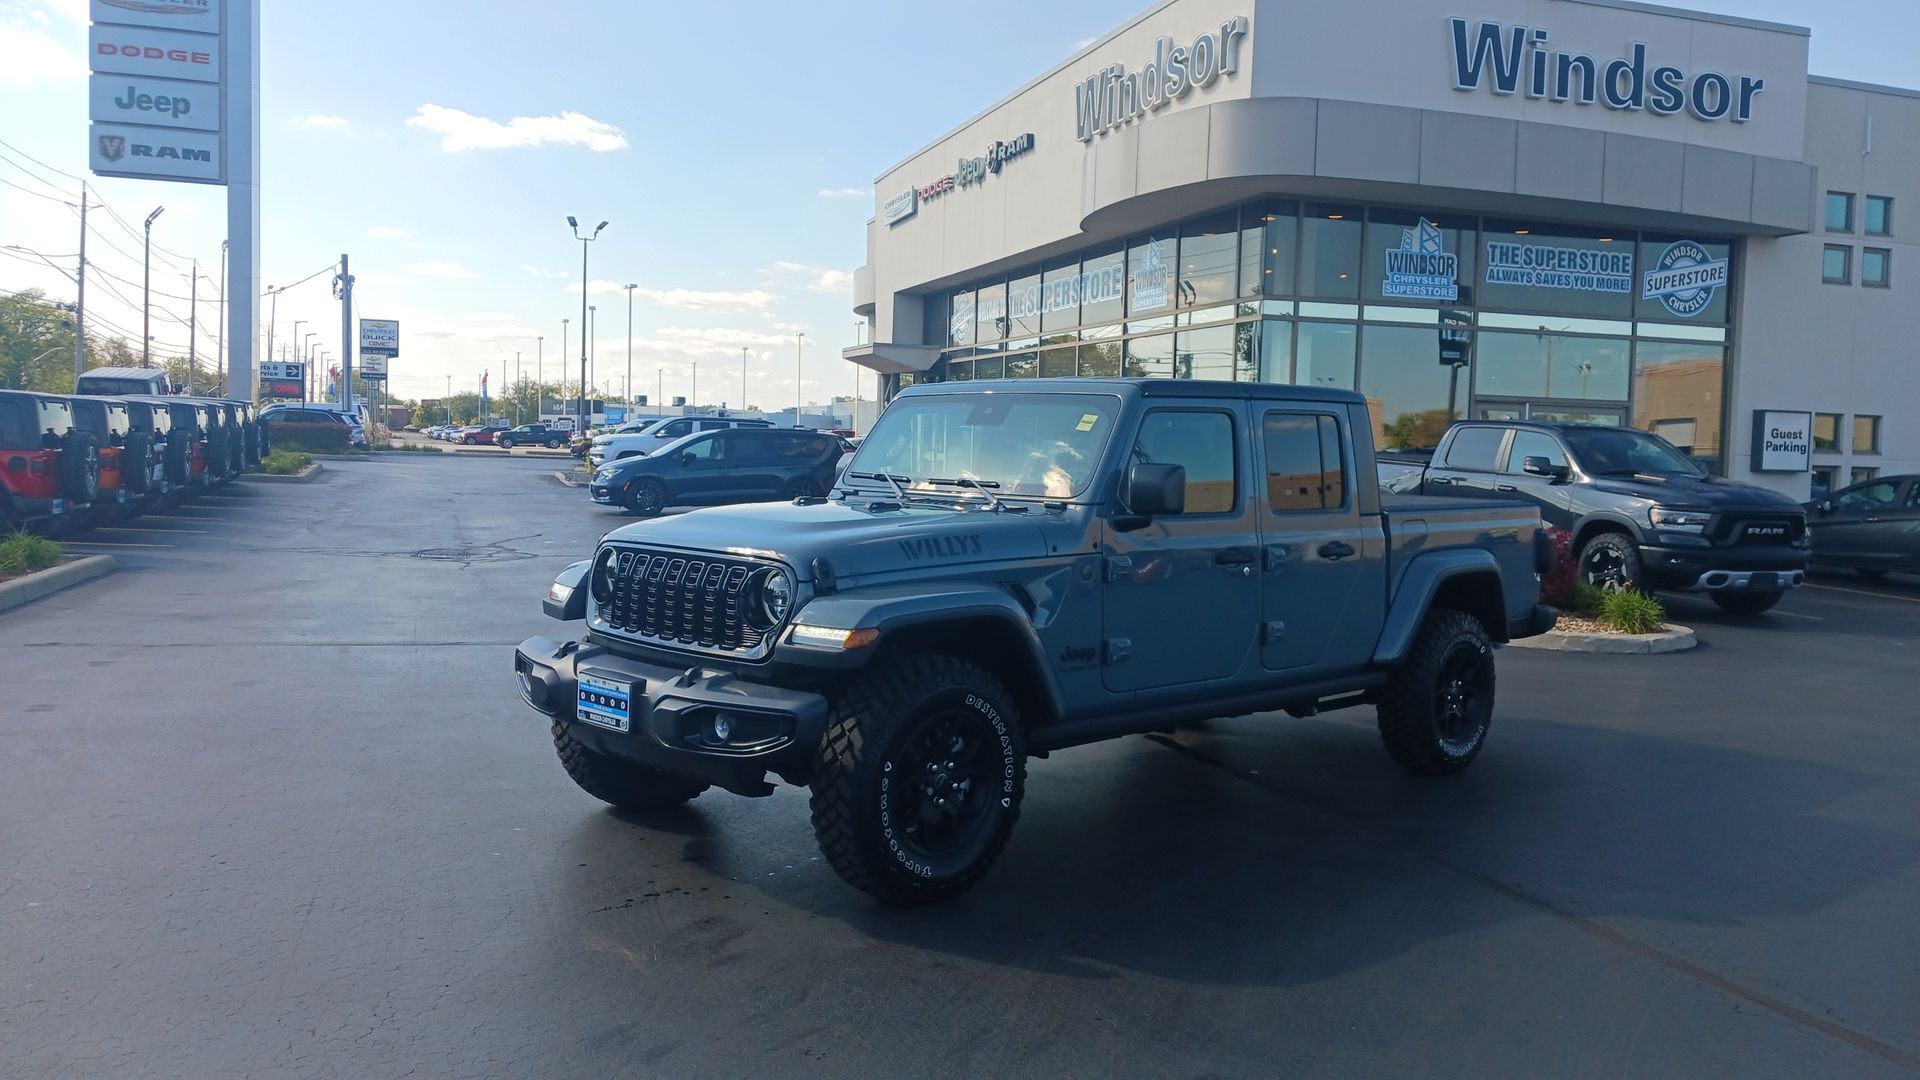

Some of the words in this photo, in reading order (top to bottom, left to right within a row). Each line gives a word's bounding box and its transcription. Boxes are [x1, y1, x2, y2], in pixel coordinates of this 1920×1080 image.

[97, 43, 211, 65] DODGE
[1075, 16, 1248, 142] Windsor
[1448, 16, 1765, 124] Windsor
[114, 86, 191, 118] Jeep
[130, 143, 211, 162] RAM
[998, 133, 1034, 161] RAM
[954, 157, 985, 187] Jeep
[884, 190, 911, 210] CHRYSLER
[917, 175, 955, 201] DODGE
[1388, 251, 1454, 277] WINDSOR
[1488, 243, 1521, 265] THE
[1522, 245, 1631, 275] SUPERSTORE
[1664, 246, 1703, 266] WINDSOR
[1010, 289, 1025, 317] THE
[1026, 263, 1123, 316] SUPERSTORE
[1385, 284, 1455, 297] SUPERSTORE
[1393, 274, 1448, 286] CHRYSLER
[1487, 268, 1533, 285] ALWAYS
[1535, 271, 1571, 288] SAVES
[1572, 273, 1595, 289] YOU
[1596, 276, 1631, 292] MORE!
[1646, 266, 1724, 292] SUPERSTORE
[1668, 290, 1708, 312] CHRYSLER
[1771, 428, 1803, 440] Guest
[1765, 441, 1807, 455] Parking
[1747, 527, 1785, 535] RAM
[897, 534, 983, 561] WILLYS
[1060, 645, 1097, 663] Jeep
[965, 695, 1014, 793] DESTINATION
